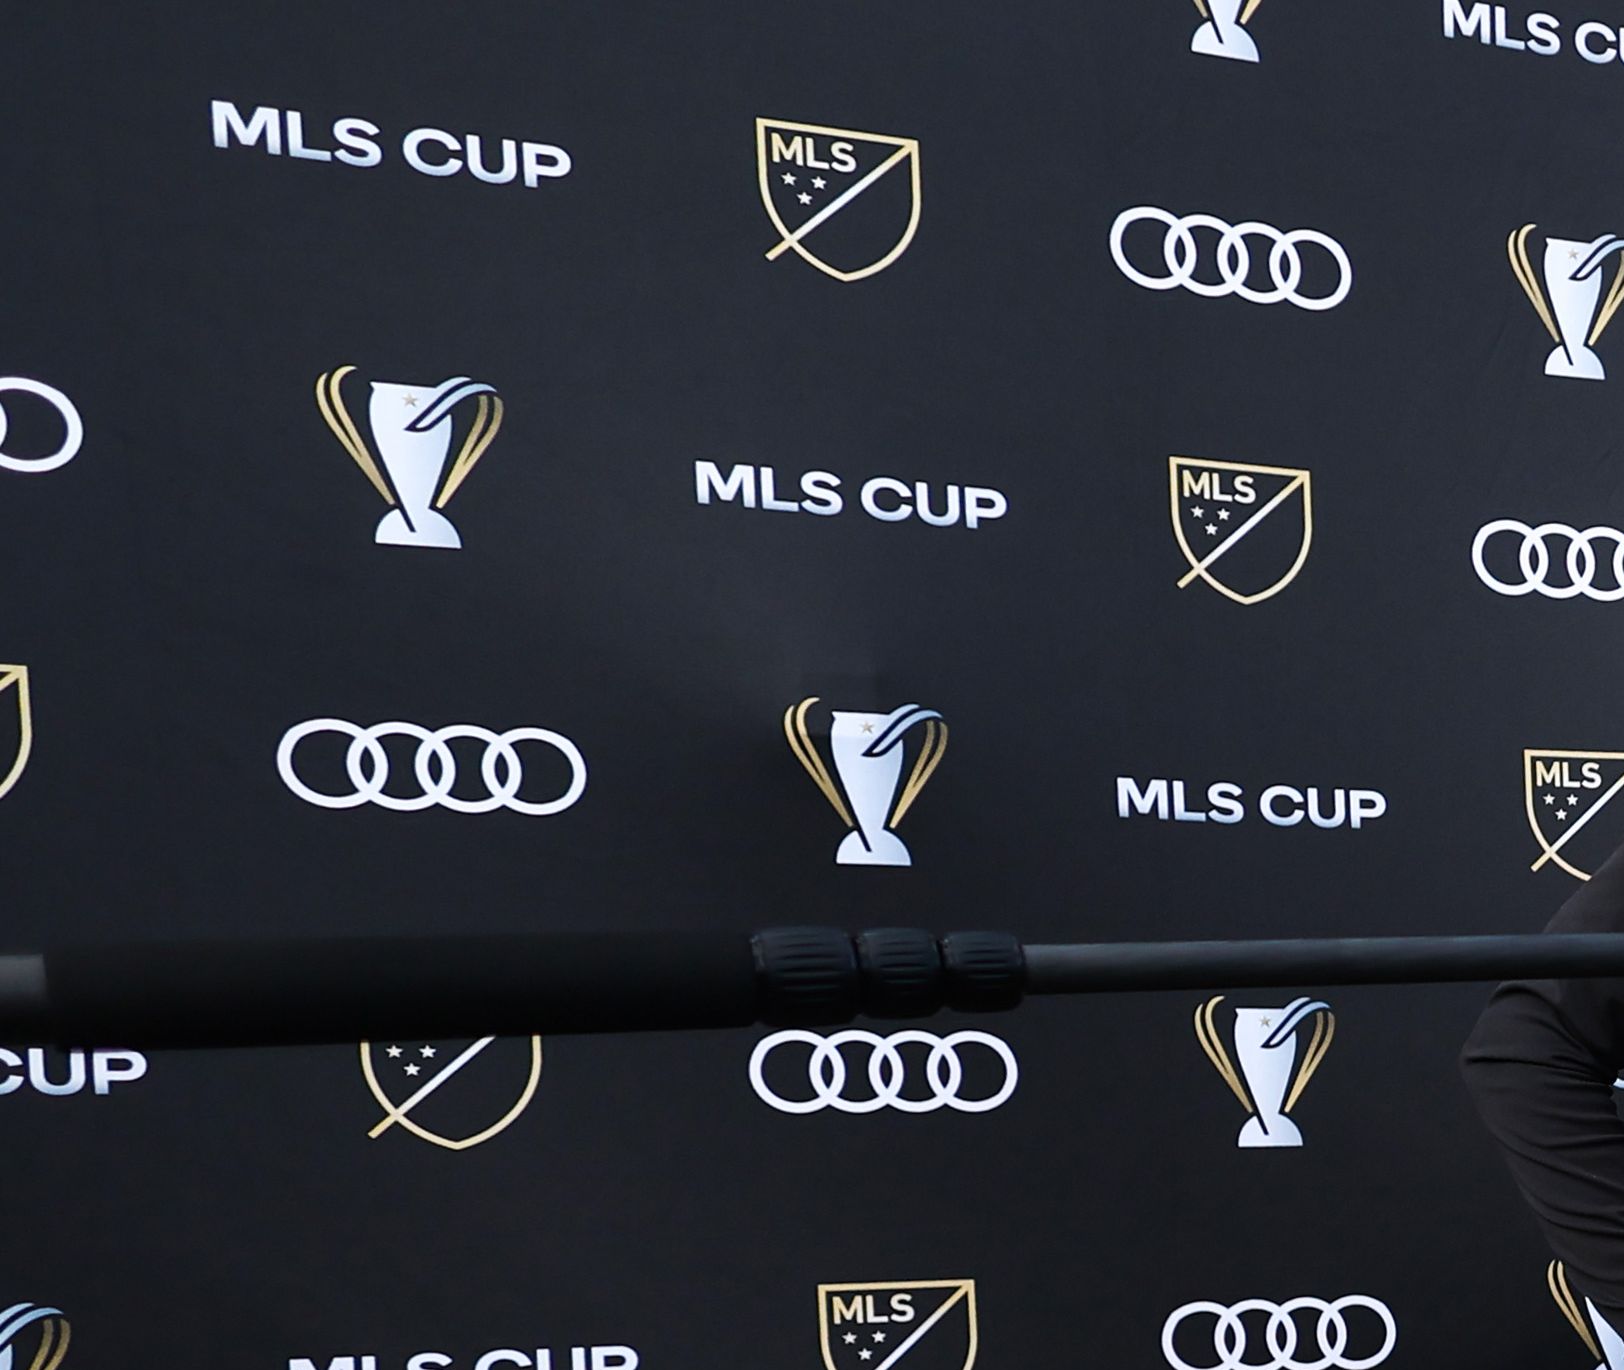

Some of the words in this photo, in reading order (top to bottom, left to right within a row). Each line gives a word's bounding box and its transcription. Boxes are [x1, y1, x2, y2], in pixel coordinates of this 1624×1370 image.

[1443, 0, 1561, 56] MLS
[211, 99, 382, 167] MLS
[402, 127, 572, 188] CUP
[771, 132, 857, 173] MLS
[695, 460, 843, 516] MLS
[860, 477, 1008, 529] CUP
[1182, 469, 1257, 504] MLS
[1535, 760, 1602, 789] MLS
[1116, 776, 1245, 824] MLS
[1259, 785, 1387, 829] CUP
[832, 1293, 915, 1325] MLS
